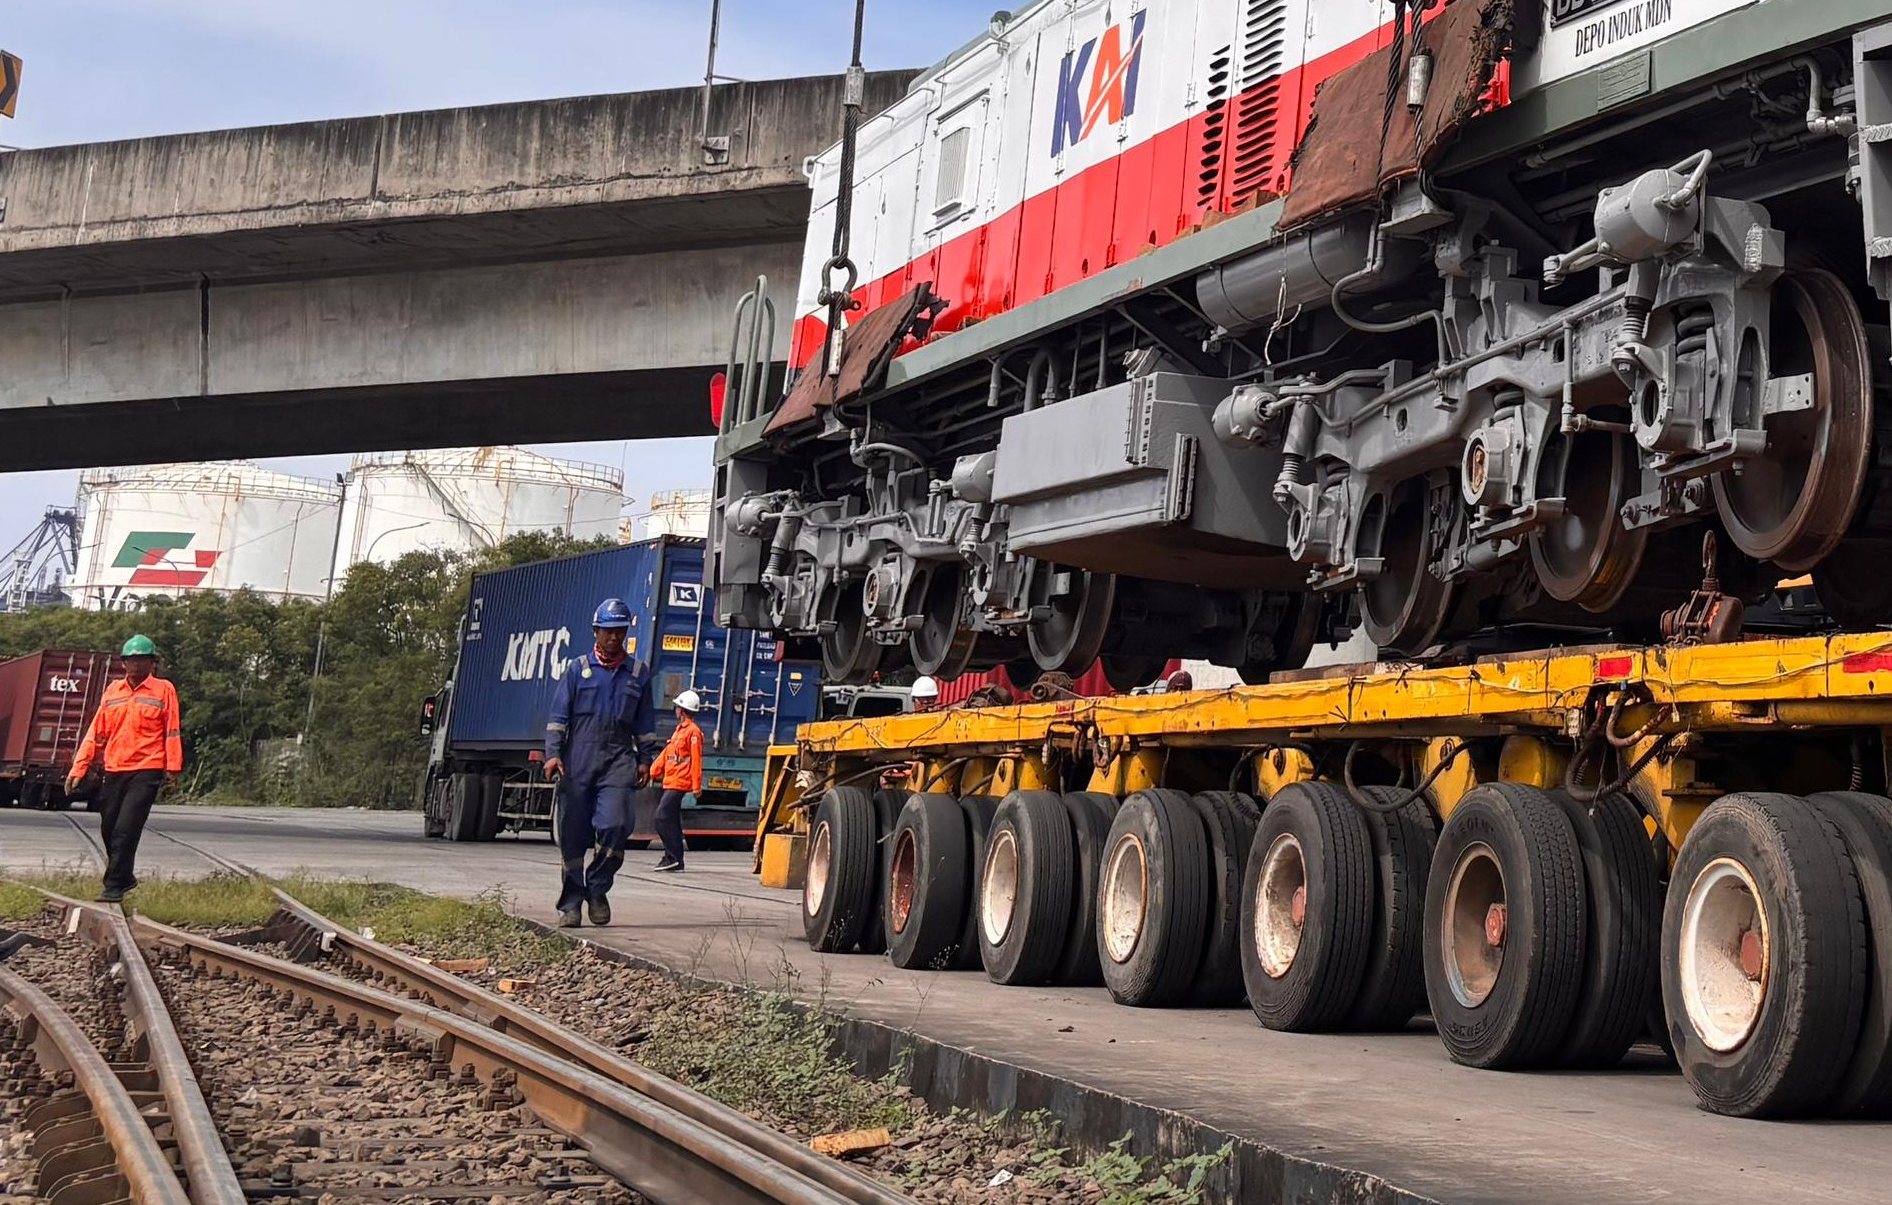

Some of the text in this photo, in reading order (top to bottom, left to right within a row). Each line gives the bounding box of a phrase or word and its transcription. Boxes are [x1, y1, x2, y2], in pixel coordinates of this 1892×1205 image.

[1575, 20, 1606, 57] DEPO
[1608, 3, 1643, 45] INDUK
[1051, 8, 1147, 158] KAI
[501, 627, 572, 681] KMTC
[50, 675, 80, 692] tex
